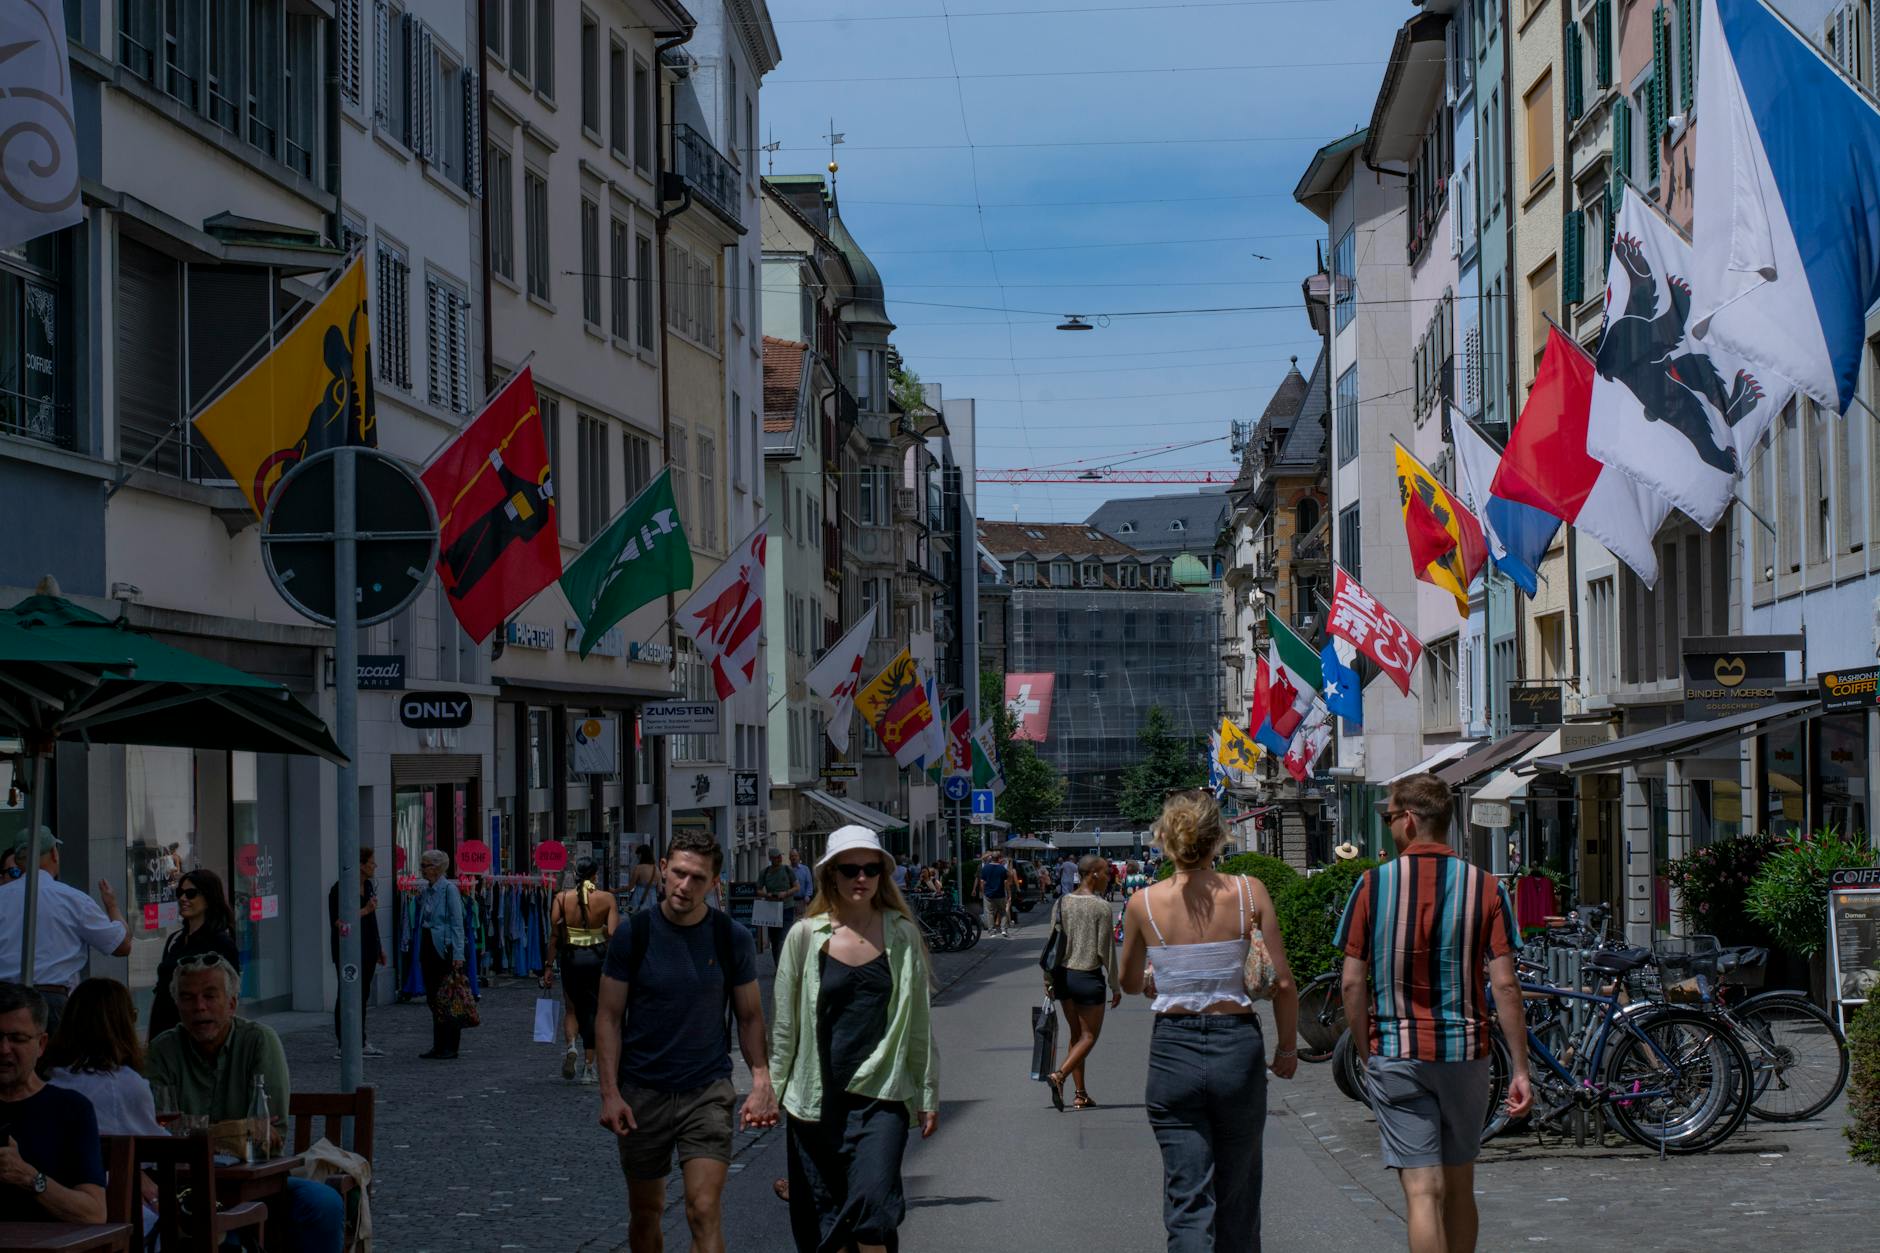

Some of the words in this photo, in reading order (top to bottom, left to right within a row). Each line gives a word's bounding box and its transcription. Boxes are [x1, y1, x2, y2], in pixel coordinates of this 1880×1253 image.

[26, 353, 53, 375] COIFFURE
[357, 663, 400, 678] acadi
[1839, 672, 1873, 682] FASHION
[1687, 689, 1726, 699] BINDER
[404, 702, 468, 718] ONLY
[647, 706, 714, 716] ZUMSTEIN
[256, 845, 273, 877] sale
[461, 852, 470, 863] 15
[471, 852, 487, 863] CHF
[1833, 869, 1880, 884] COIFF
